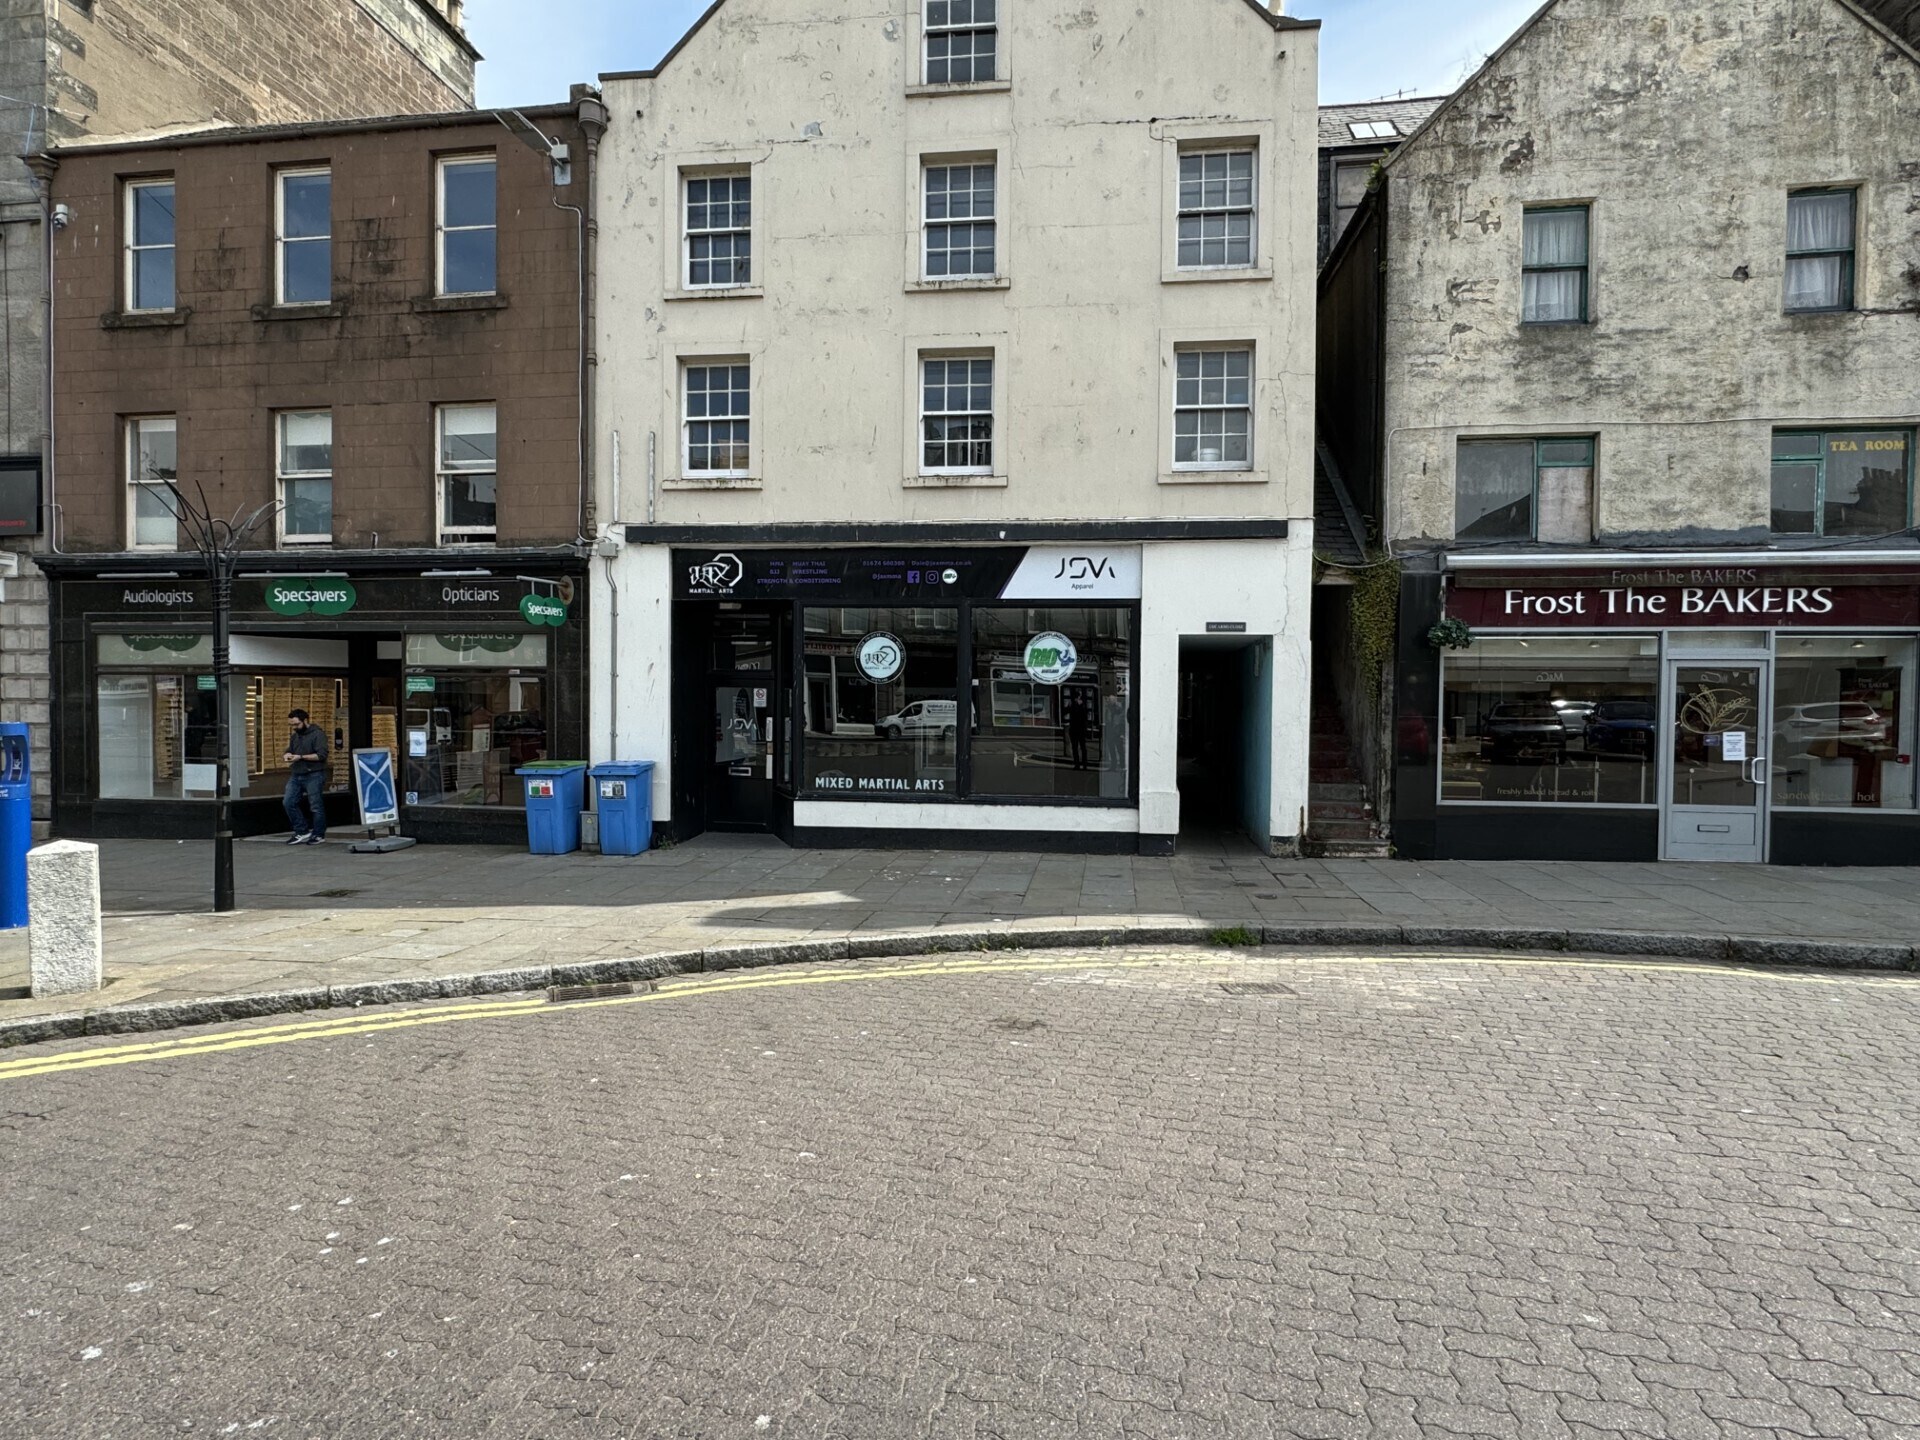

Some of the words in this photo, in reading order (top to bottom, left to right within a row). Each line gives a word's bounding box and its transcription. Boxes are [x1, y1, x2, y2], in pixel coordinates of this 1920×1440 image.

[1831, 441, 1858, 451] TEA
[1865, 440, 1905, 450] ROOM
[1612, 570, 1649, 584] Frost
[1654, 570, 1684, 584] The
[1691, 569, 1756, 583] BAKERS
[123, 589, 193, 606] Audiologists
[274, 587, 346, 604] Specsavers
[442, 587, 500, 604] Opticians
[1504, 589, 1586, 614] Frost
[1599, 588, 1666, 614] The
[1680, 588, 1833, 613] BAKERS
[528, 602, 563, 617] Specsavers
[1028, 648, 1058, 668] RIO
[816, 777, 853, 788] MIXED
[859, 778, 910, 790] MARTIAL
[915, 780, 945, 790] ARTS
[1497, 787, 1521, 796] freshly
[1572, 788, 1578, 796] &
[1857, 792, 1875, 801] hot
